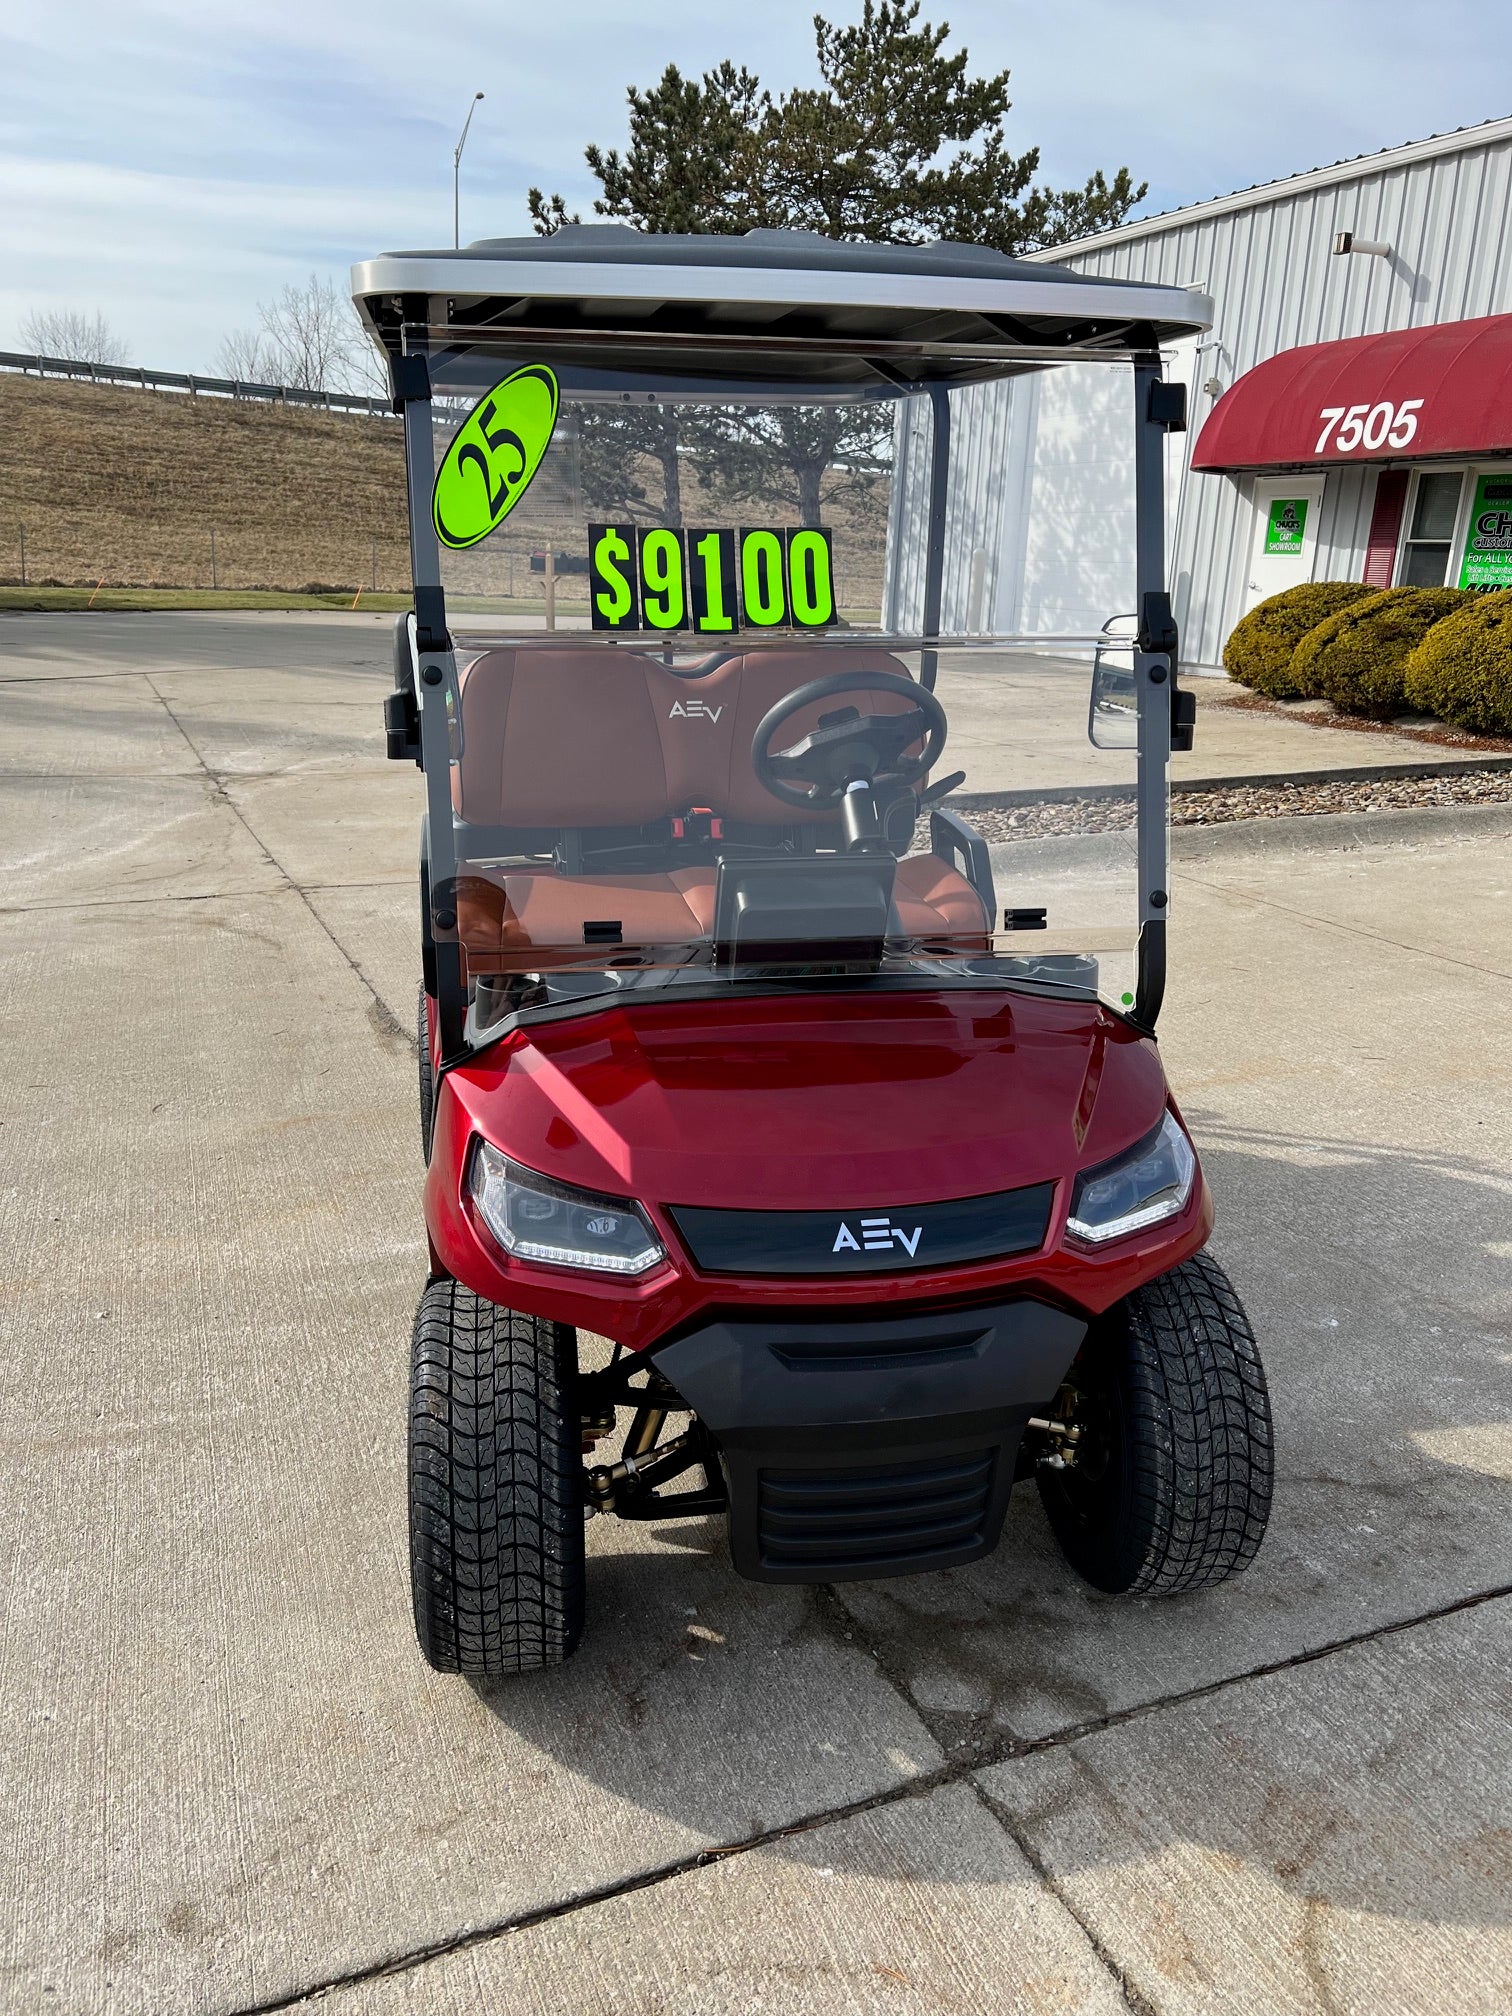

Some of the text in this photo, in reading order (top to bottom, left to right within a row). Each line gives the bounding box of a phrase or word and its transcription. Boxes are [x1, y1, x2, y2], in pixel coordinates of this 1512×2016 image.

[1314, 398, 1425, 454] 7505
[457, 399, 527, 521] 25
[1268, 542, 1300, 551] SHOWROOM
[1279, 533, 1293, 541] CART
[1466, 552, 1482, 563] For
[1484, 552, 1502, 563] ALL
[593, 527, 833, 632] $9100
[669, 700, 723, 724] AEV
[832, 1218, 923, 1258] AEV
